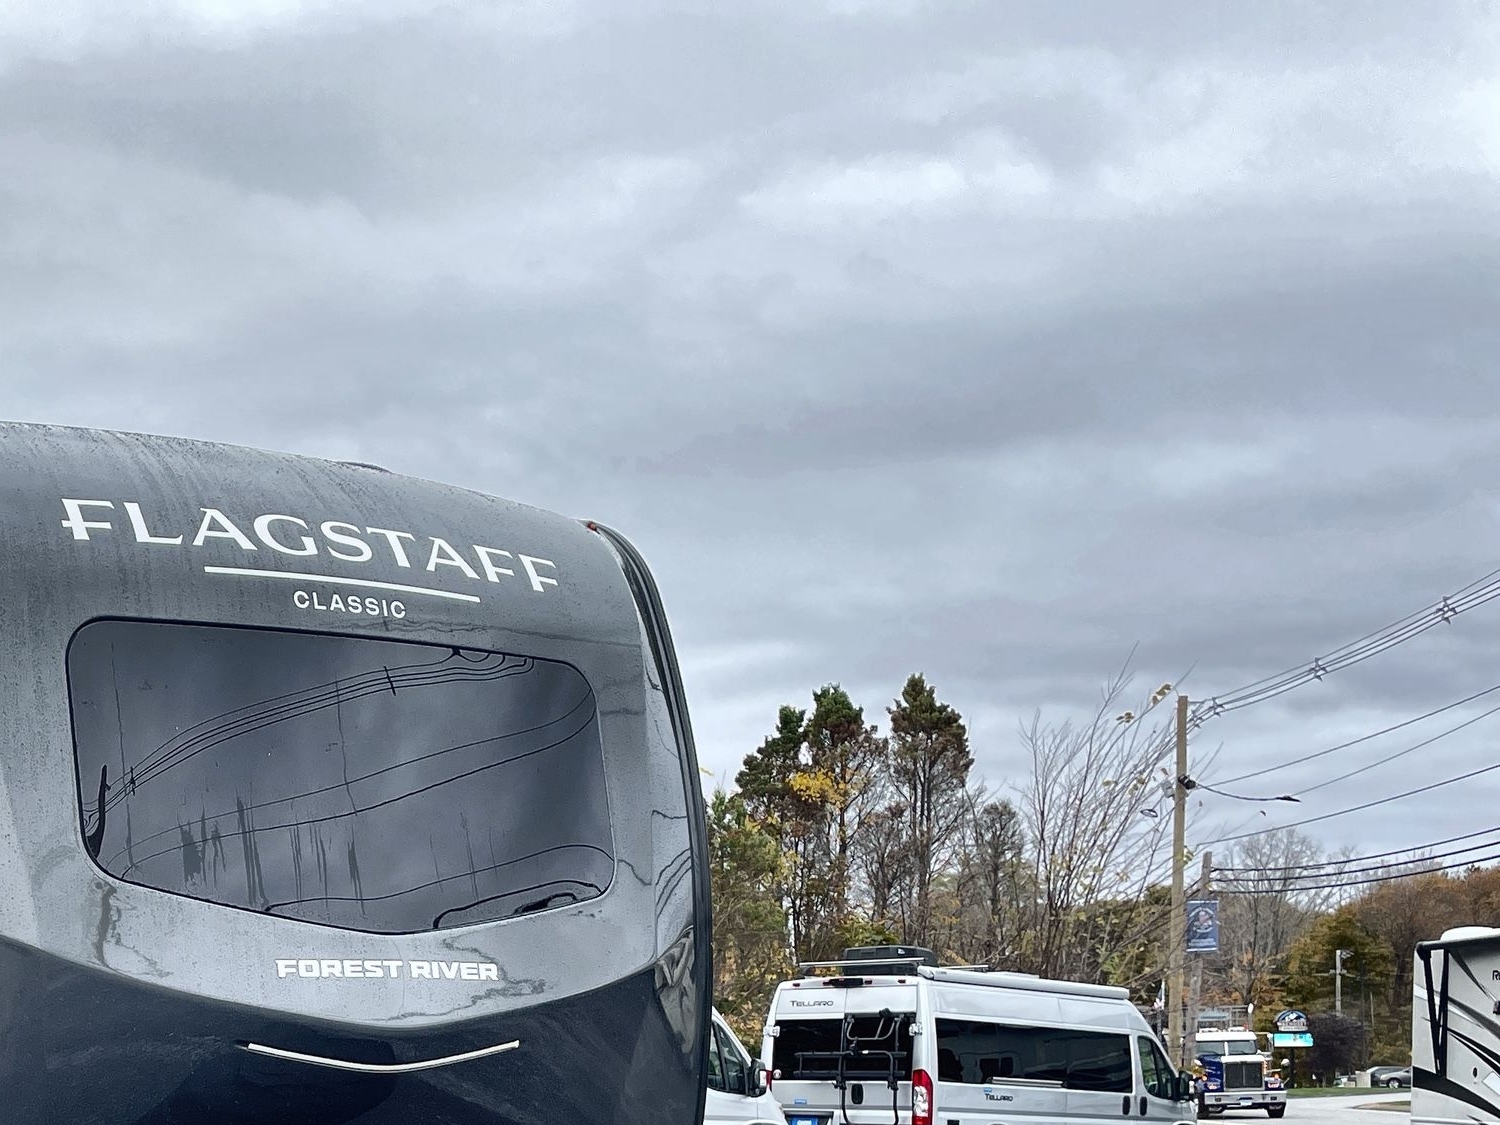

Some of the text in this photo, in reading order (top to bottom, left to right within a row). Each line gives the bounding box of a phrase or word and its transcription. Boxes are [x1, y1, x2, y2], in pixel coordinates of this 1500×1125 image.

[61, 498, 559, 592] FLAGSTAFF
[293, 590, 407, 619] CLASSIC
[275, 959, 498, 981] FOREST RIVER
[1492, 970, 1500, 981] R
[985, 1093, 1014, 1102] TELLARO
